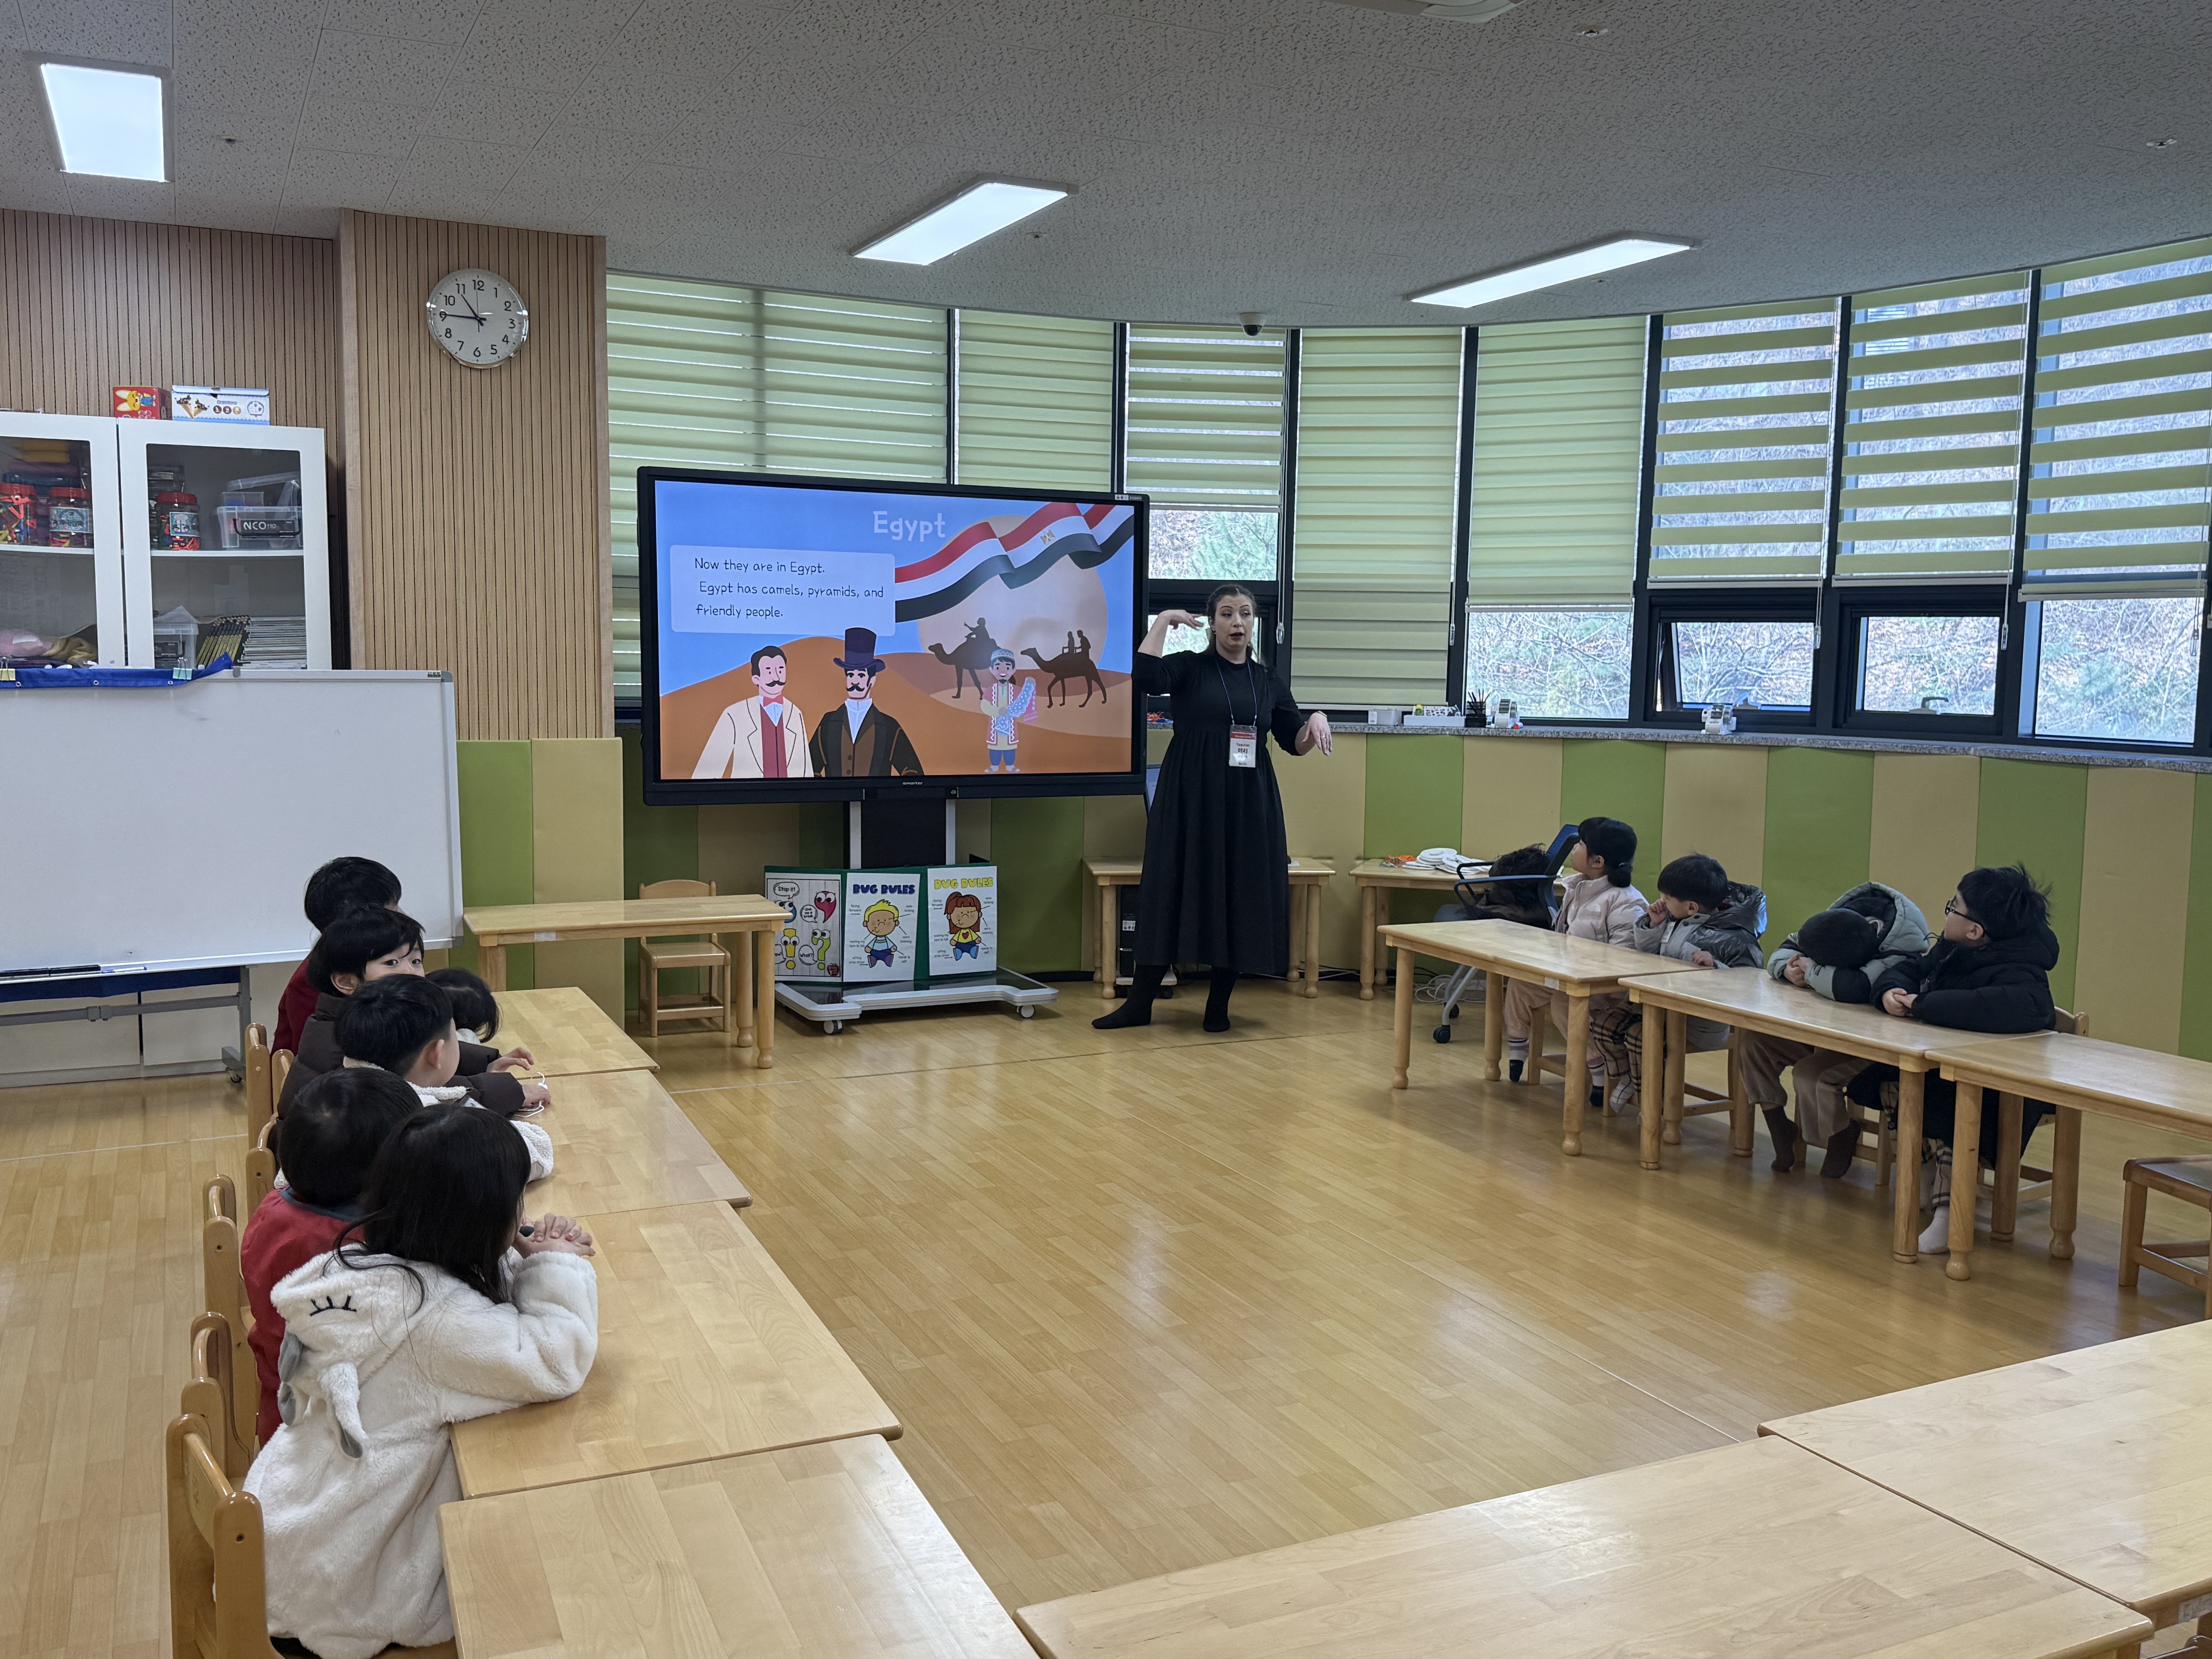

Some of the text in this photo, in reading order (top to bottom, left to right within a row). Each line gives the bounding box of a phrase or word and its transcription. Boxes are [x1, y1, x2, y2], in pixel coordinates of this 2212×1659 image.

[456, 283, 465, 294] 11
[472, 280, 484, 291] 12
[494, 287, 497, 298] 1
[444, 295, 455, 306] 10
[504, 301, 511, 311] 2
[508, 318, 515, 329] 3
[445, 328, 452, 338] 8
[502, 334, 510, 344] 4
[457, 341, 464, 351] 7
[490, 344, 497, 354] 5
[473, 347, 481, 357] 6
[243, 522, 266, 530] NCO
[873, 511, 945, 542] Egypt
[695, 558, 825, 575] Now they are in Egypt.
[700, 581, 883, 598] Egypt has camels, pyramids, and
[696, 604, 783, 619] friendly people.
[881, 884, 915, 895] RULES
